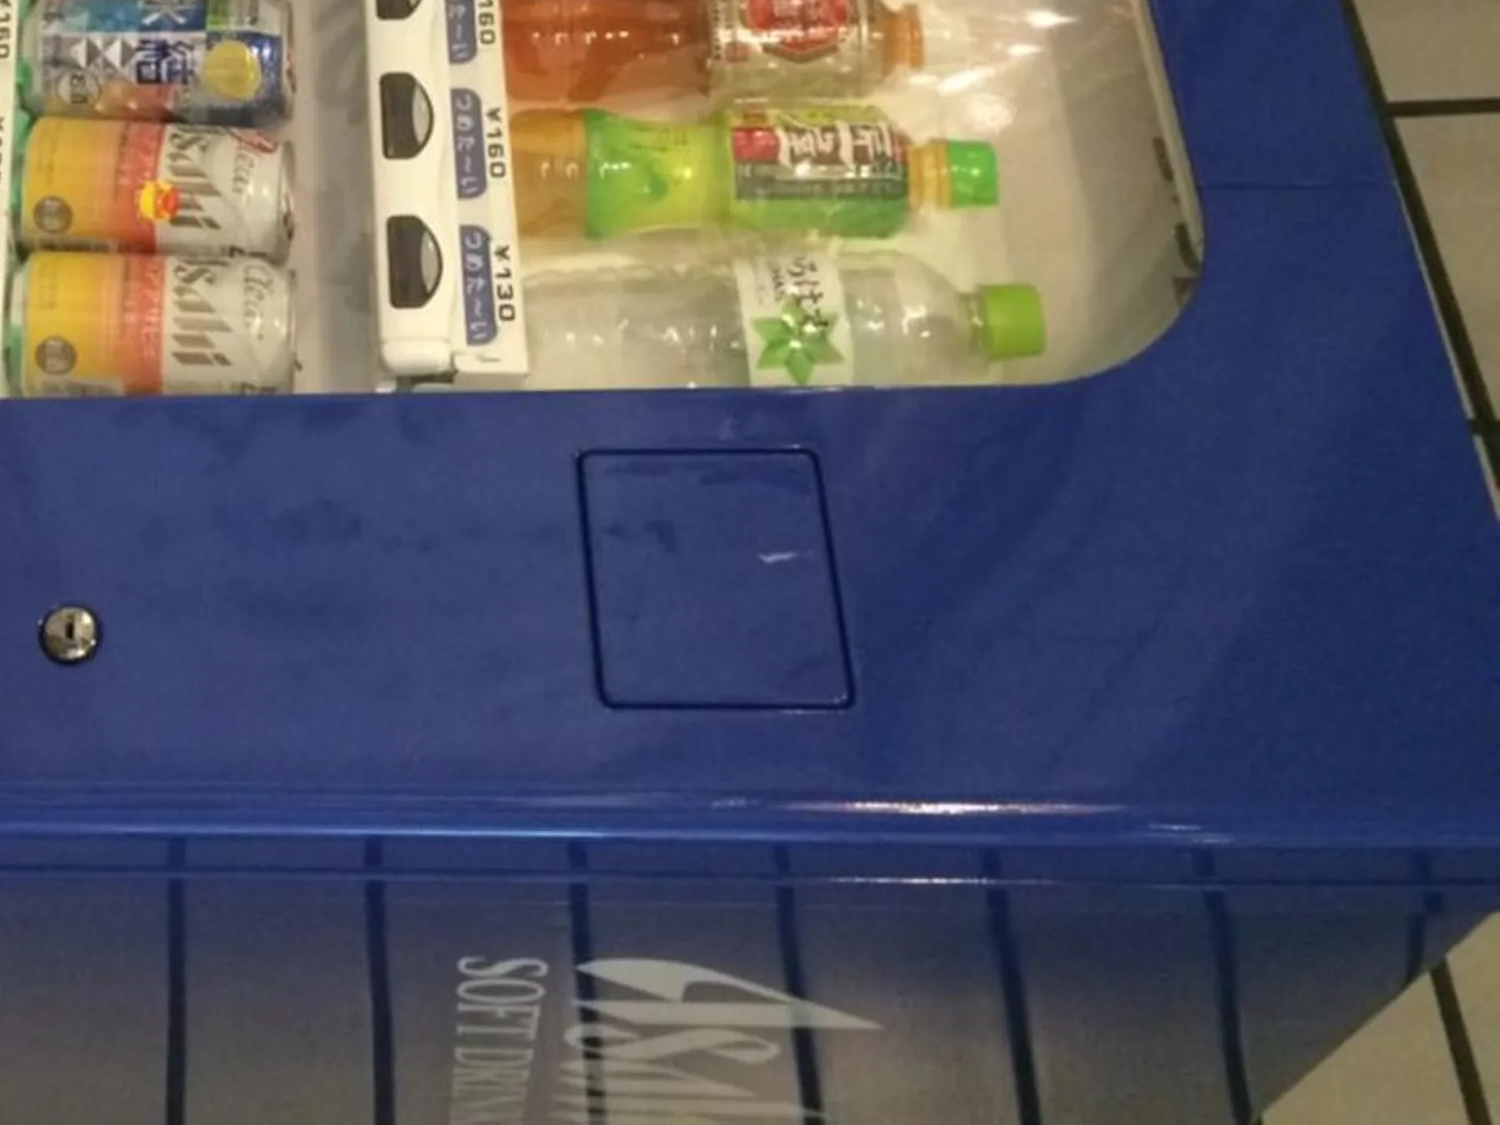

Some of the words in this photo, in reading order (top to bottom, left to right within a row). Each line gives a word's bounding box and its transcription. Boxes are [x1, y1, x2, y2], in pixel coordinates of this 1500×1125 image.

[486, 106, 506, 179] ¥160
[494, 244, 515, 323] ¥130
[455, 956, 550, 1042] SOFT
[450, 1046, 534, 1125] DRIN
